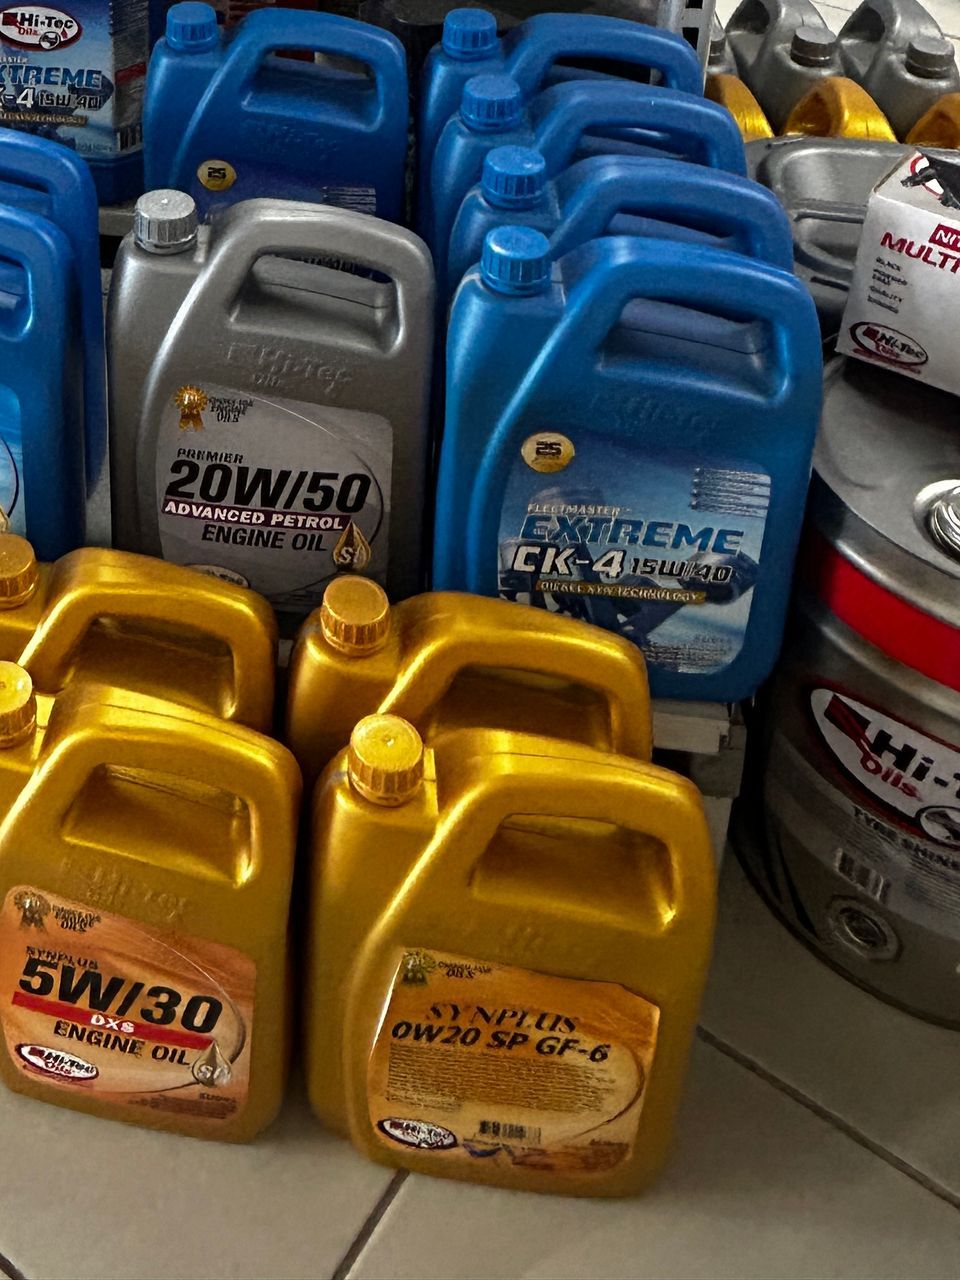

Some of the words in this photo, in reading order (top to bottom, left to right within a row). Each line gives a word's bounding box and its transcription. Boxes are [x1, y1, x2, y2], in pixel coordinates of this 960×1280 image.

[19, 12, 74, 29] Hi-Tec
[207, 167, 227, 180] 25
[177, 448, 244, 464] PREMIER
[535, 441, 562, 457] 25
[165, 459, 372, 513] 20W/50
[164, 501, 265, 525] ADVANCED
[271, 513, 343, 530] PETROL
[202, 524, 285, 549] ENGINE
[292, 532, 327, 552] OIL
[520, 515, 744, 554] EXTREME
[513, 544, 627, 578] CK-4
[630, 557, 734, 584] 15W/40
[616, 586, 699, 603] TECHNOLOGY
[860, 752, 921, 800] Oils
[18, 958, 223, 1034] 5W/30
[426, 1002, 578, 1034] SYNPLUS
[54, 1019, 145, 1056] ENGINE
[151, 1043, 191, 1066] OIL
[391, 1019, 481, 1047] 0W20
[486, 1031, 529, 1050] SP
[535, 1035, 612, 1064] GF-6
